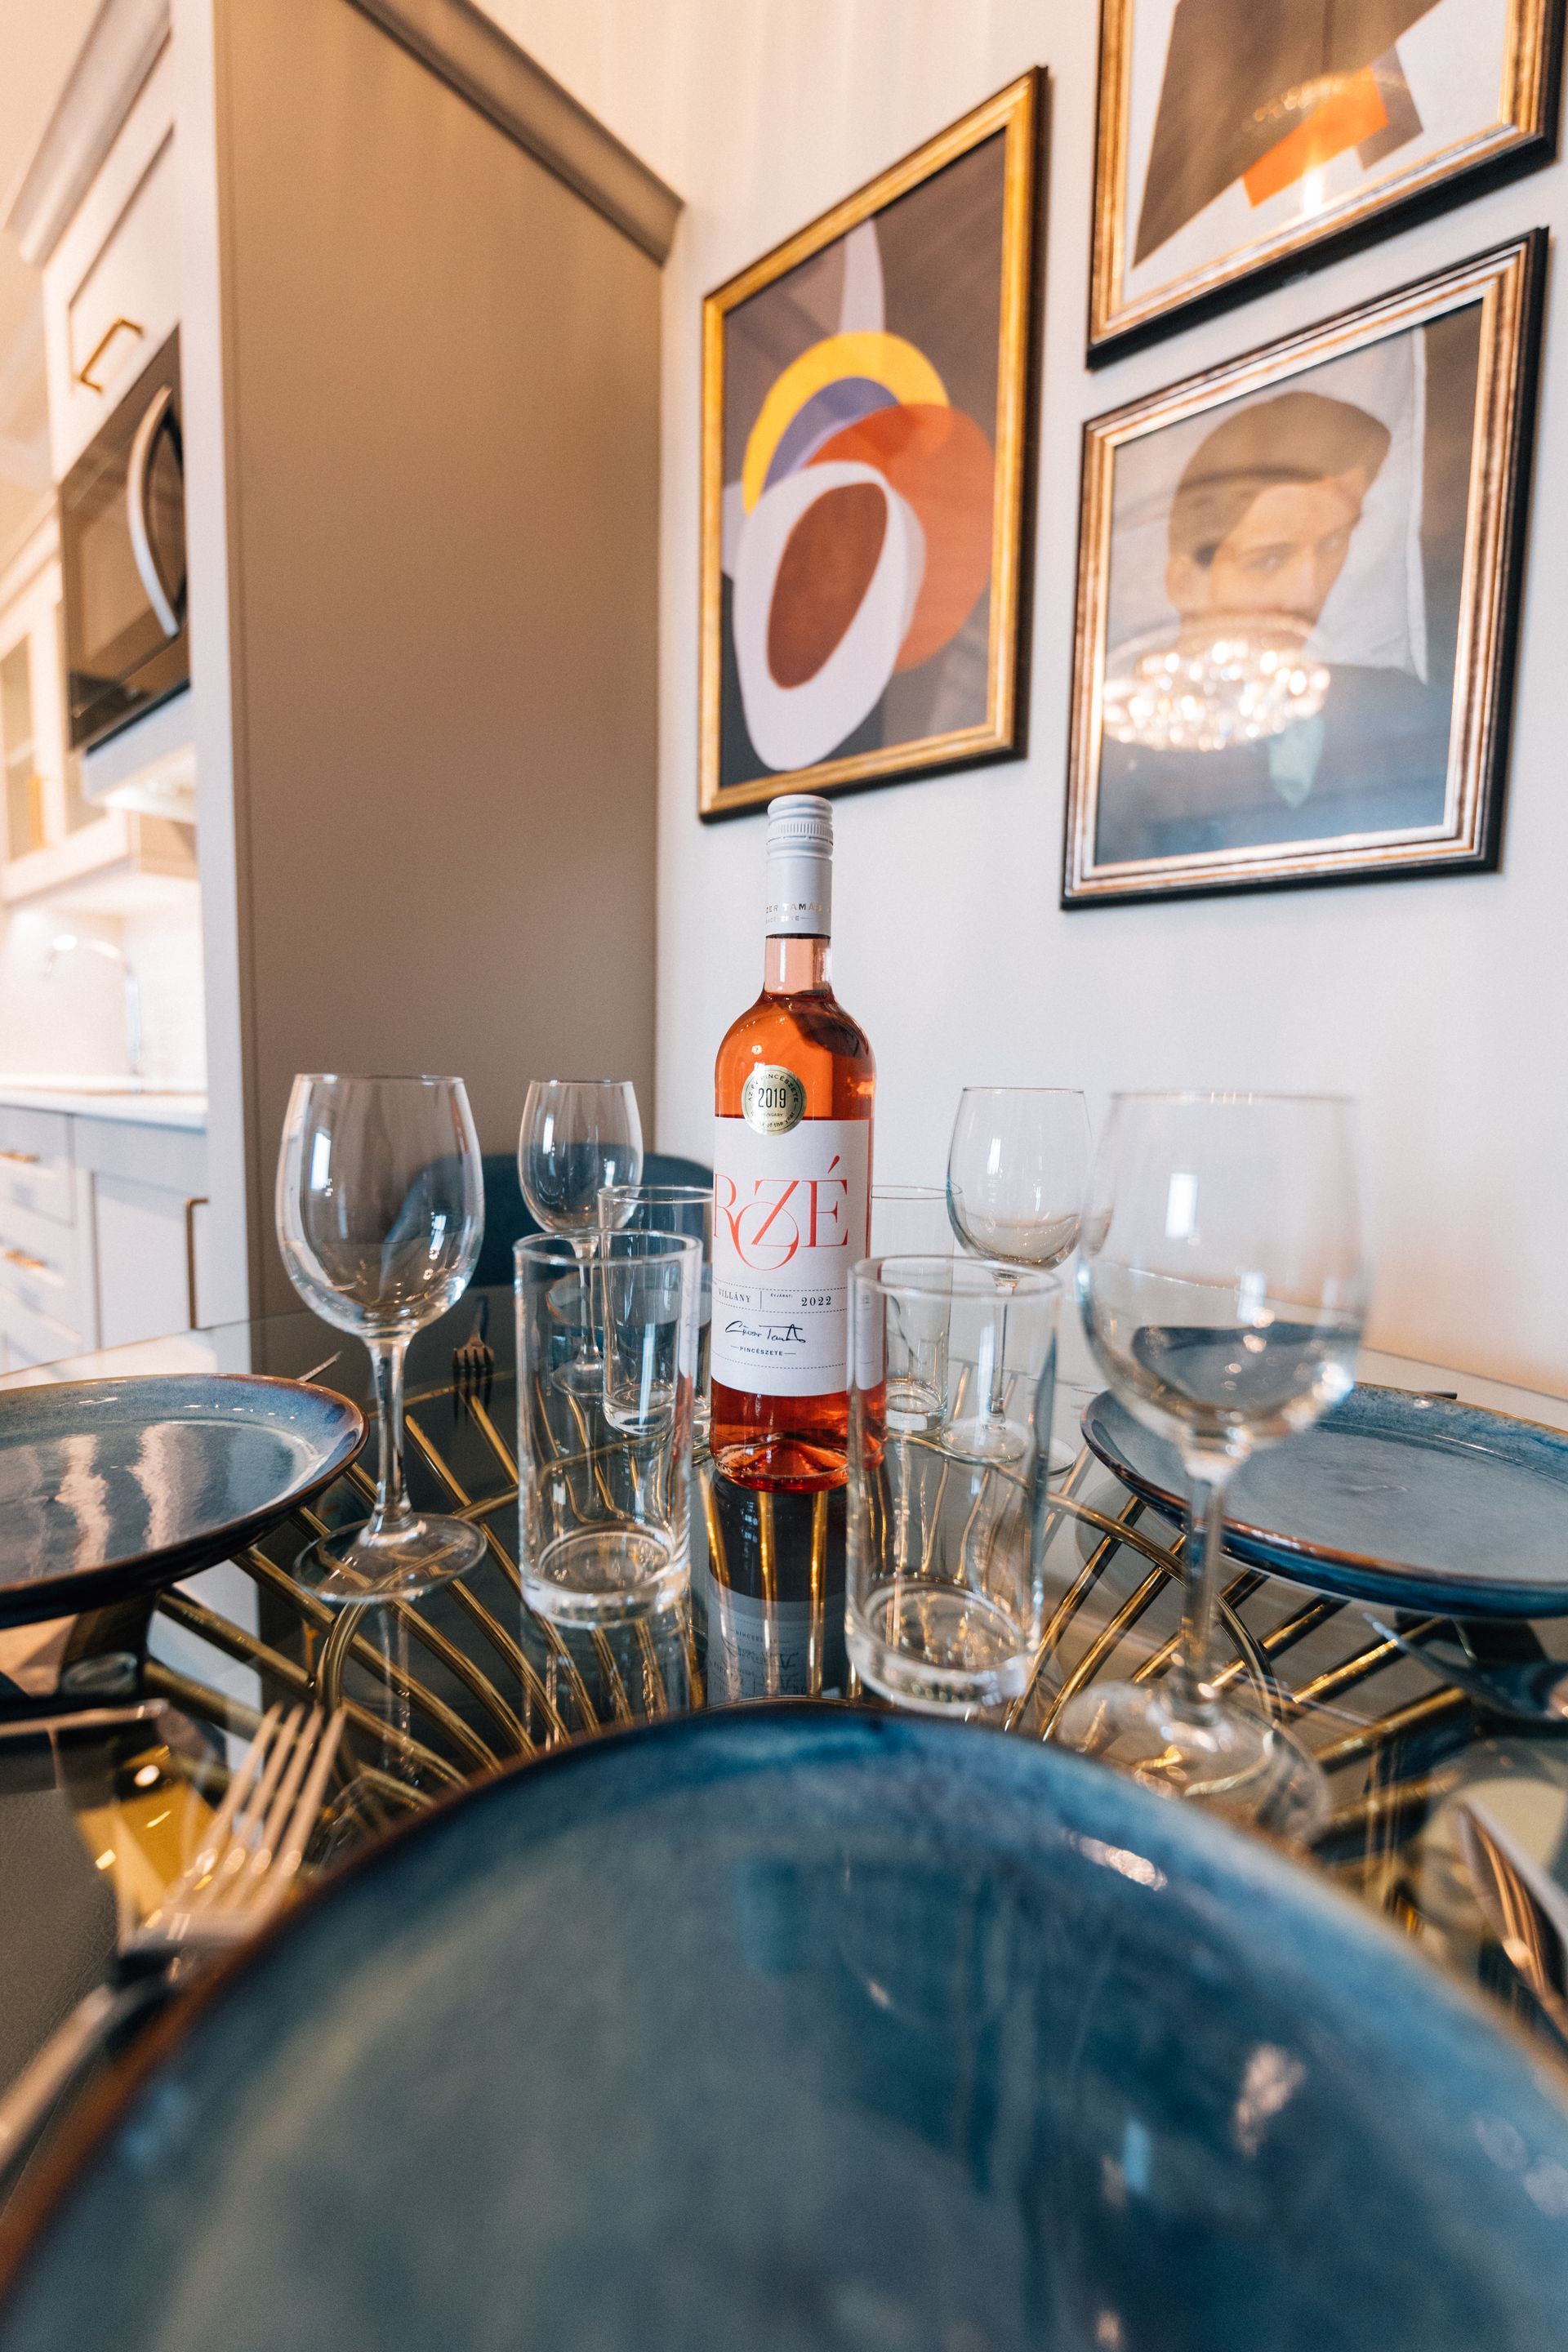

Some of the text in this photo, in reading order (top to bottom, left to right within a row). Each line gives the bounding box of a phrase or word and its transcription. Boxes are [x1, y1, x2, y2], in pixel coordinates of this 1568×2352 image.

[759, 1088, 786, 1108] 2019
[719, 1288, 751, 1303] VILLÁNY
[801, 1296, 831, 1307] 2022
[739, 1347, 783, 1356] PINCÉSZETE
